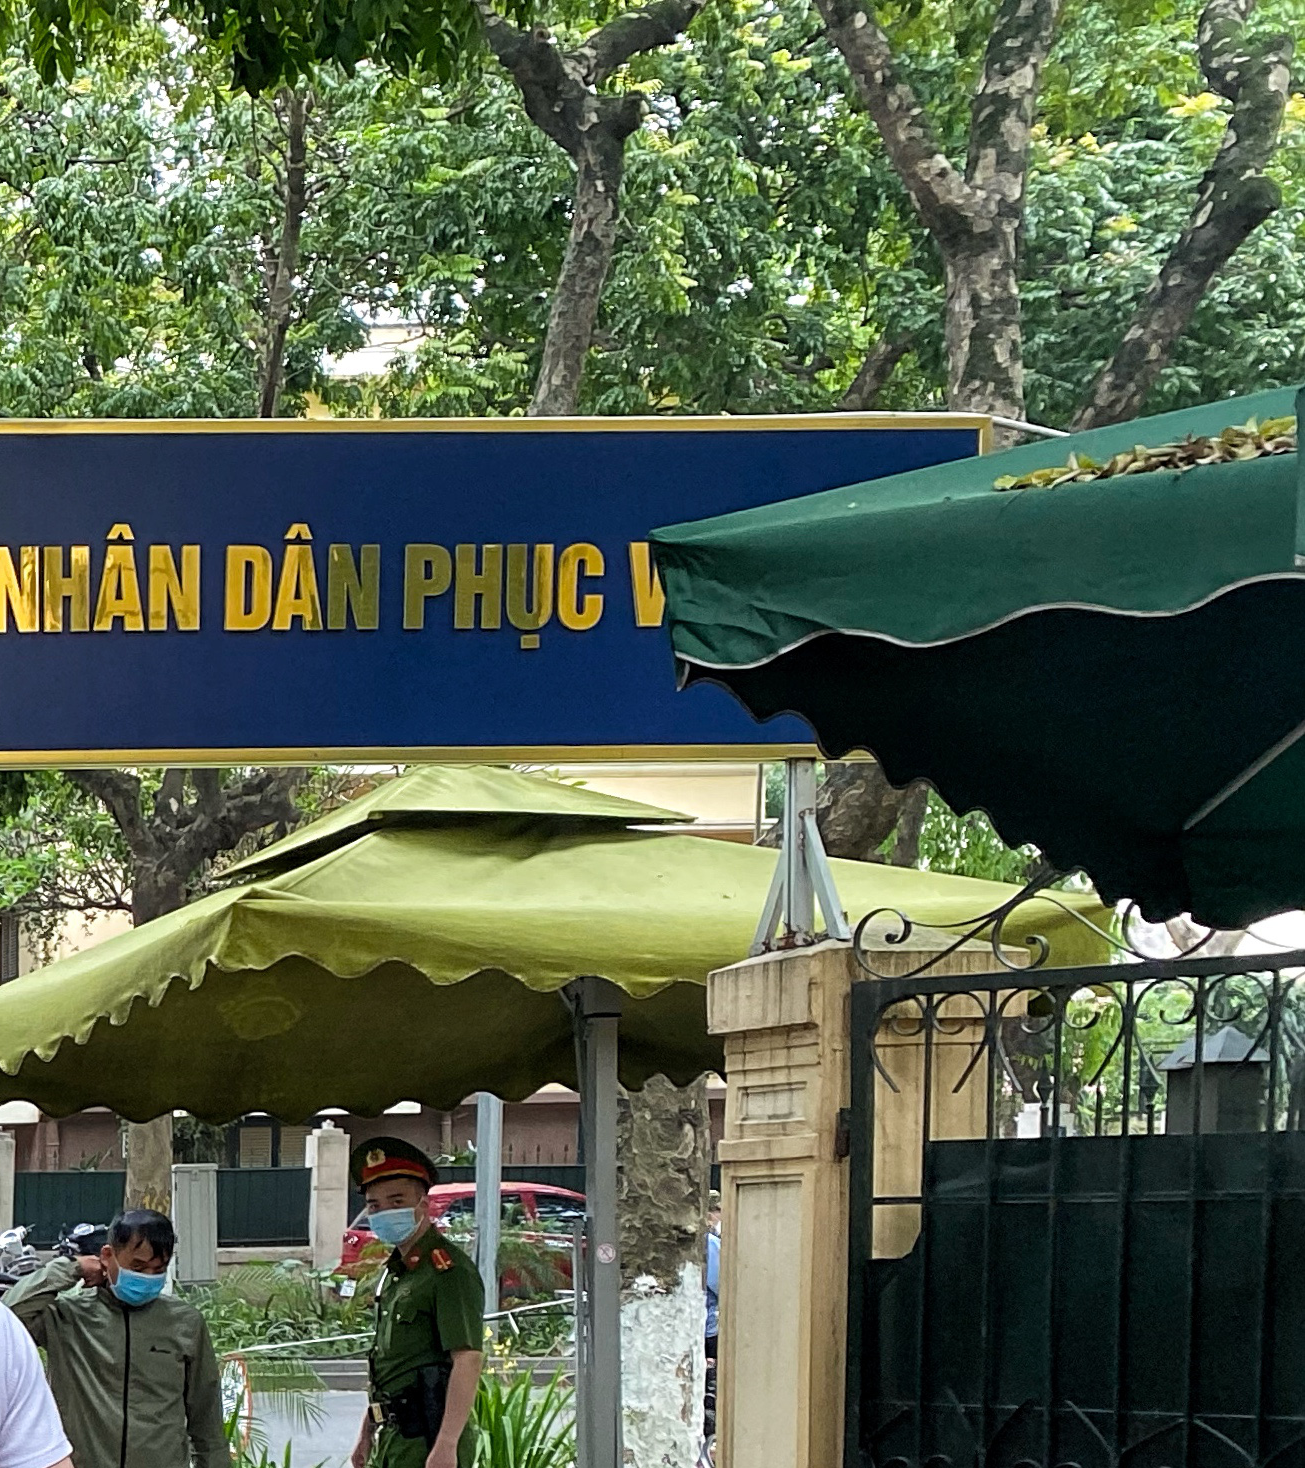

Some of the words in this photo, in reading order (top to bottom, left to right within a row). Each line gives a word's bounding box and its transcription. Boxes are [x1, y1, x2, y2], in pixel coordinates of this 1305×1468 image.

[223, 523, 379, 631] DÂN
[402, 542, 605, 650] PHỤC
[629, 541, 666, 627] V
